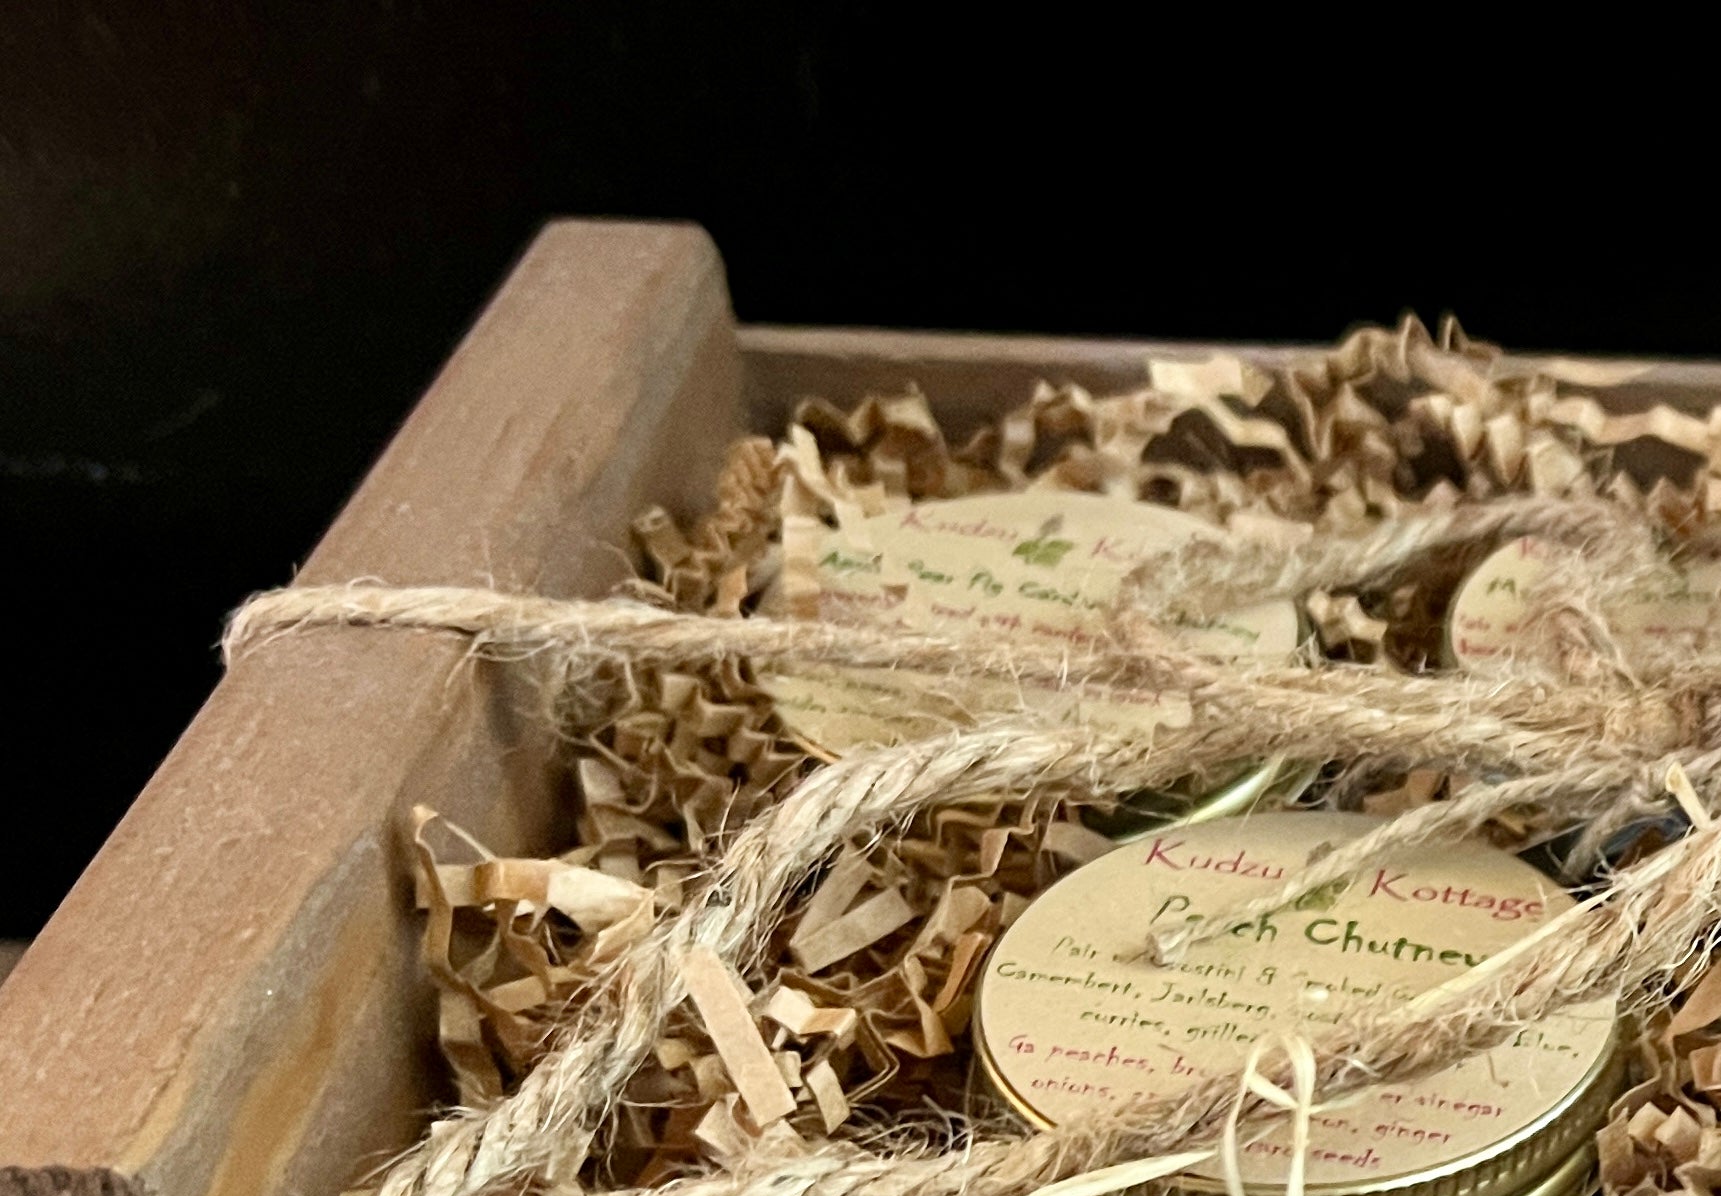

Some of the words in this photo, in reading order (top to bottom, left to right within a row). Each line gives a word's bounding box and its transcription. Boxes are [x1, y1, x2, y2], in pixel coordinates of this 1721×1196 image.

[1144, 838, 1286, 881] Kudzu
[1368, 868, 1546, 922] Kottage
[996, 961, 1142, 999] Camembert,
[1150, 981, 1277, 1021] Jarlsberg,
[1079, 1010, 1171, 1037] curries,
[1047, 1046, 1156, 1075] peaches,
[1030, 1076, 1117, 1101] onions,
[1374, 1120, 1452, 1145] ginger
